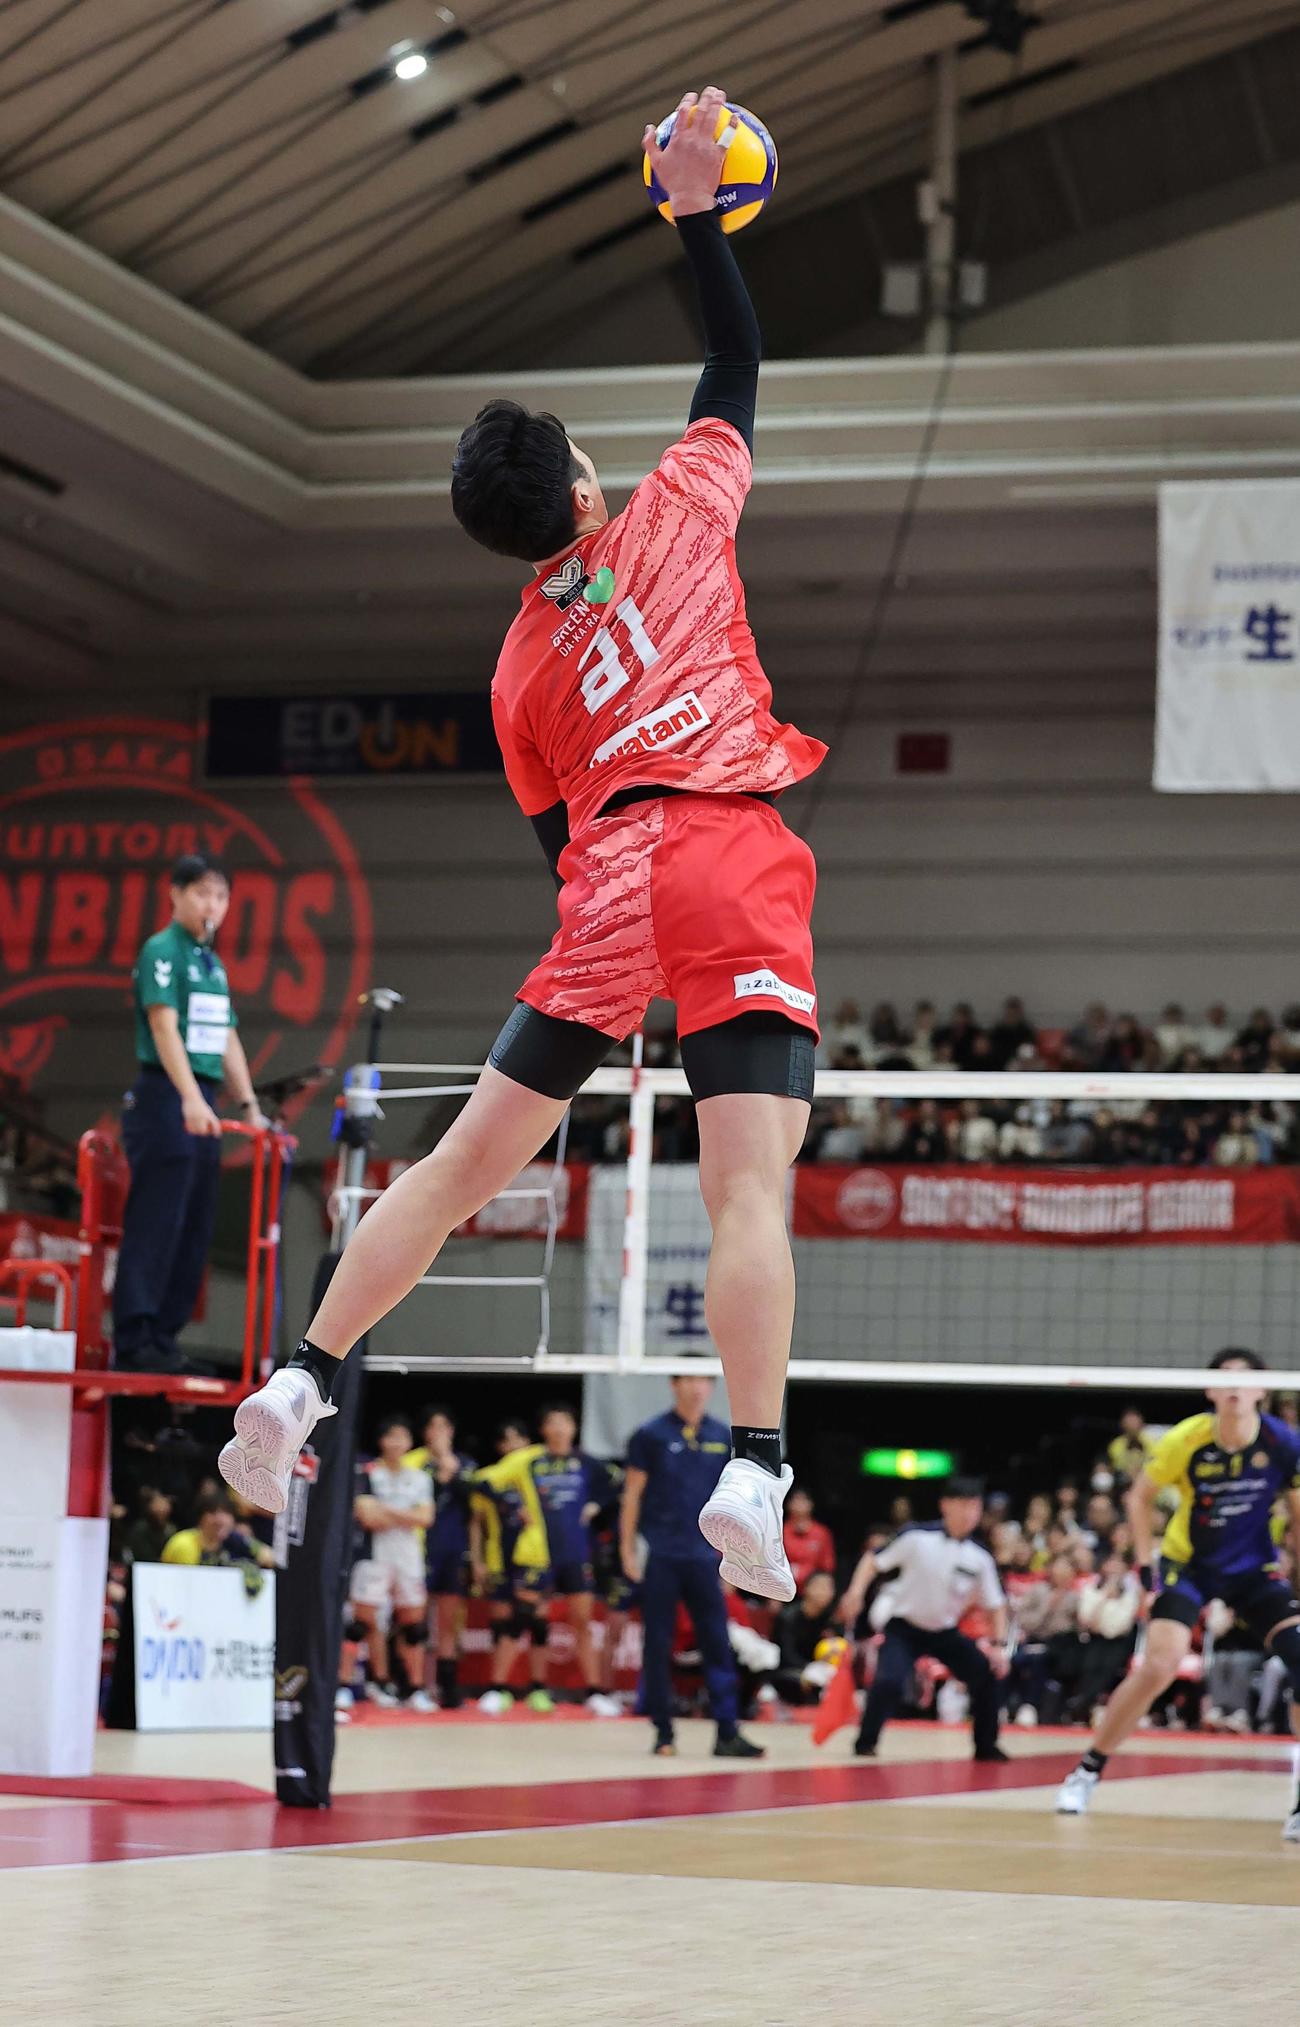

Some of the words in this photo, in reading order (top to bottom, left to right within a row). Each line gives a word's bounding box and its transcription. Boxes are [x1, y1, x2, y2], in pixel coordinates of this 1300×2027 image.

[281, 699, 458, 768] EDION
[6, 822, 238, 859] UNTORY
[0, 870, 335, 1026] NBIDS
